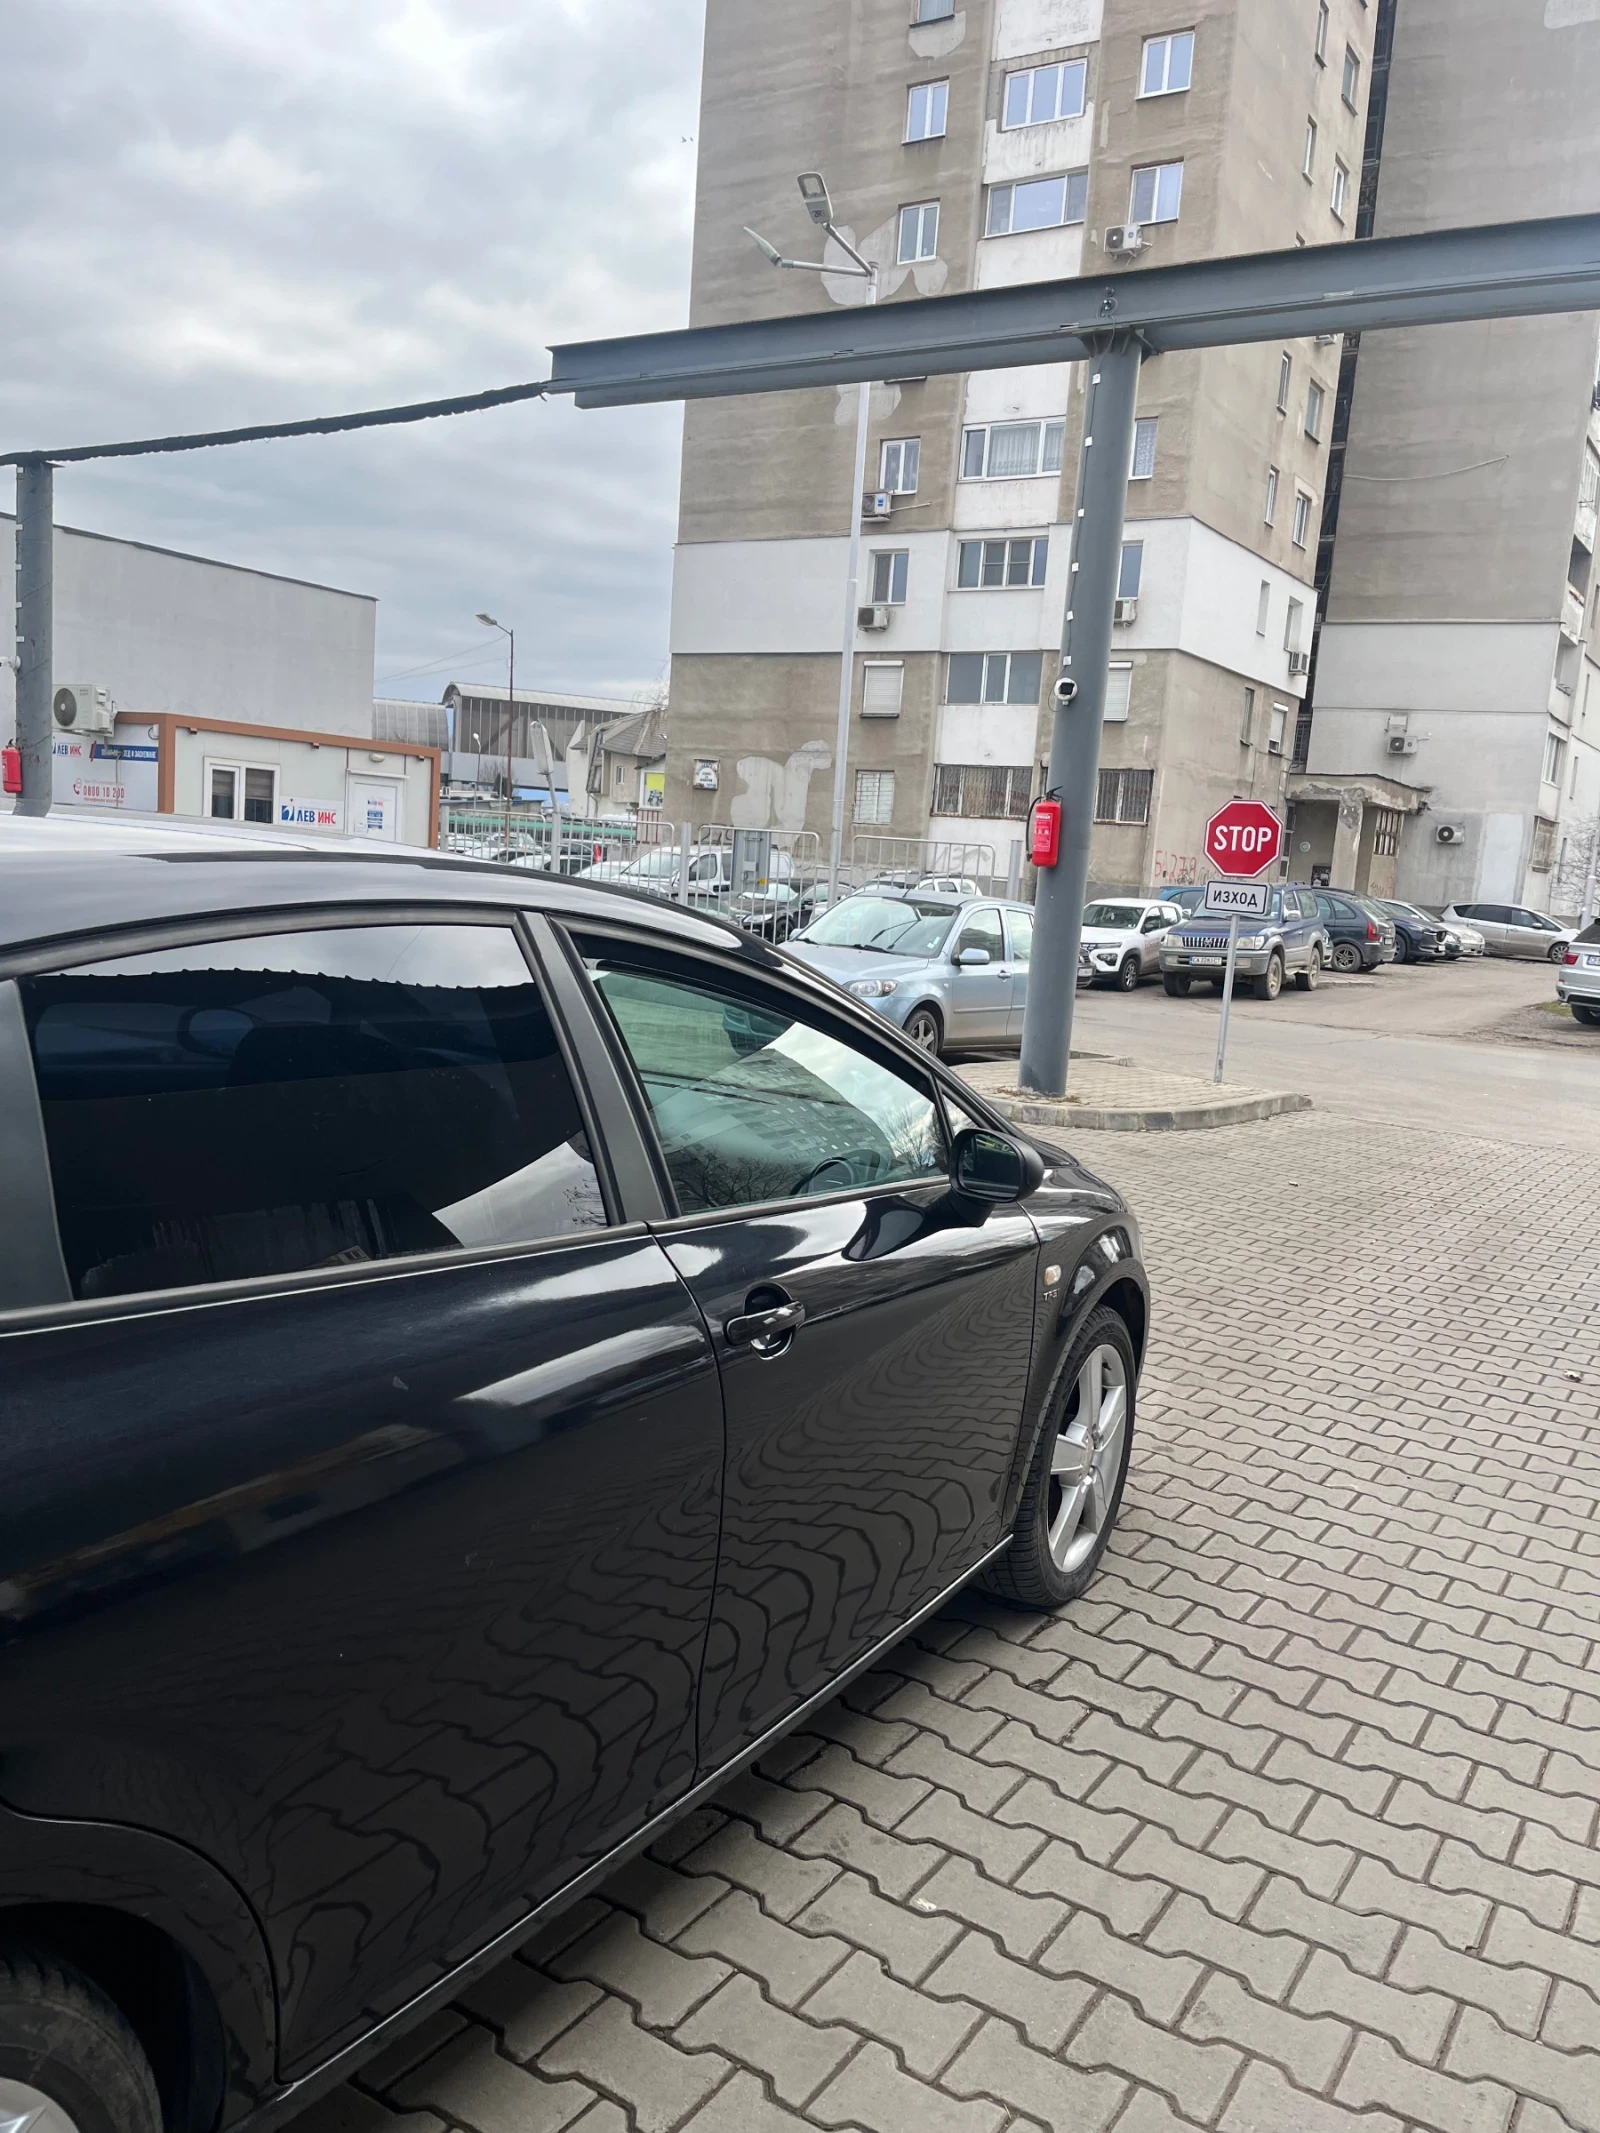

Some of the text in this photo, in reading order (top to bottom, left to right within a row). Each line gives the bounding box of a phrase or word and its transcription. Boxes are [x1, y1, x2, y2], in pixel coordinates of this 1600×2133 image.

[57, 744, 68, 754] ЛЕВ
[83, 785, 125, 799] 0800 10 200
[296, 810, 337, 824] ЛЕВ ИНС
[1213, 825, 1272, 852] STOP
[1213, 890, 1258, 908] ИЗХОД
